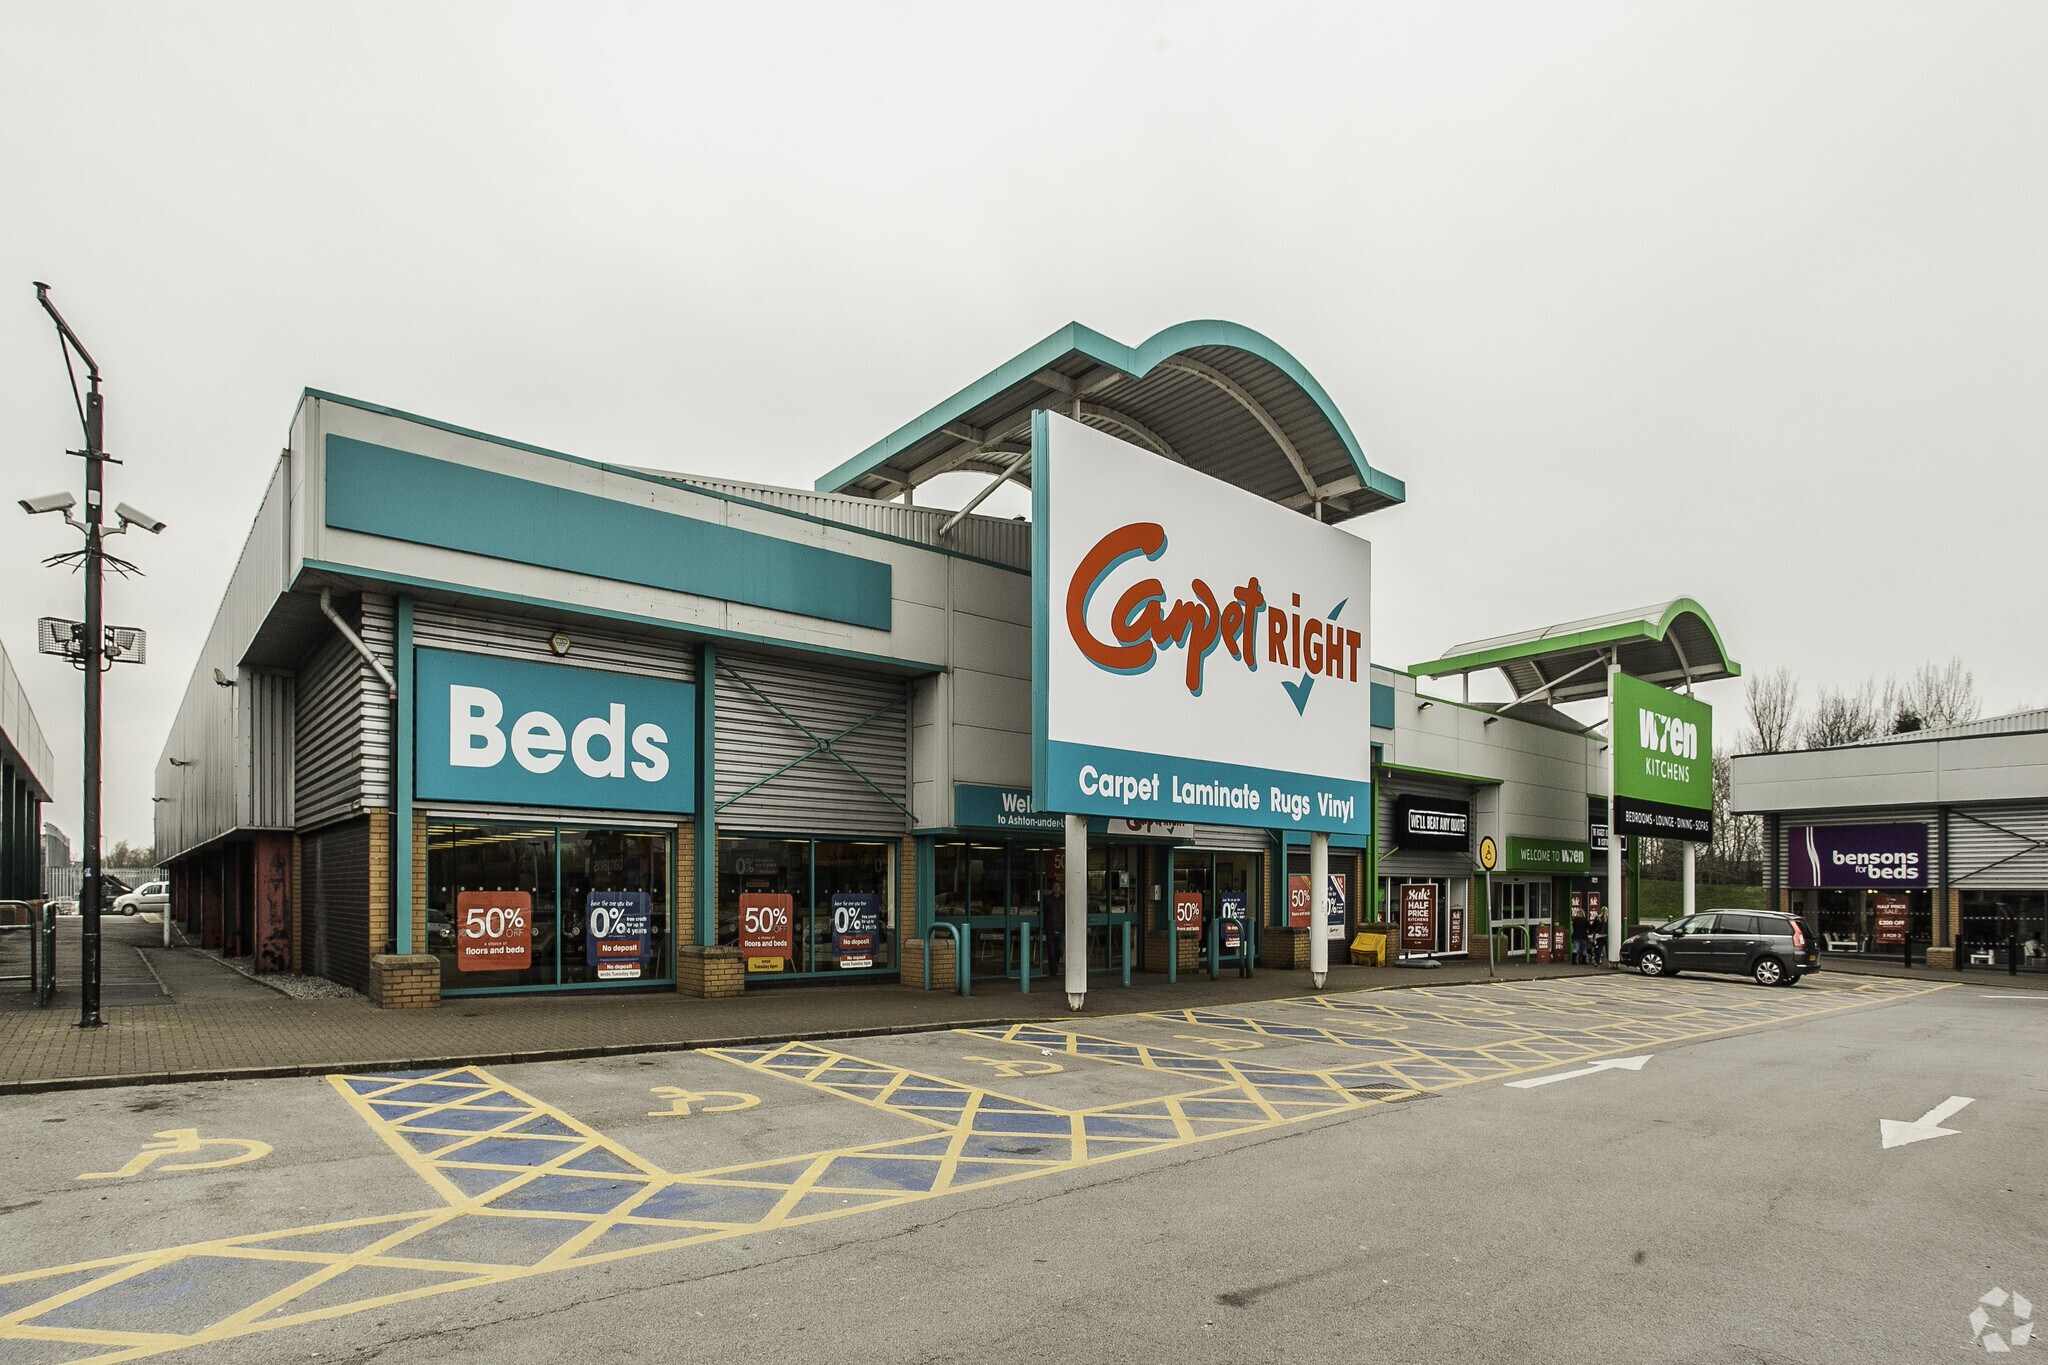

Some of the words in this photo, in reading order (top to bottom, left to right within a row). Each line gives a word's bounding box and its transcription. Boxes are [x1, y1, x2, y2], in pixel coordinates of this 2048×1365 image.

[450, 684, 669, 782] Beds
[1645, 757, 1690, 783] KITCHENS
[1079, 764, 1160, 806] Carpet
[1172, 775, 1261, 811] Laminate
[1270, 787, 1311, 822] Rugs
[1317, 792, 1355, 824] Vinyl
[997, 814, 1006, 825] to
[1008, 815, 1066, 828] Ashton-under-L
[1427, 815, 1440, 830] BEAT
[1440, 817, 1450, 831] ANY
[1451, 818, 1466, 832] QUOTE
[1625, 810, 1653, 825] BEDROOMS
[1655, 815, 1674, 828] LOUNGE
[1677, 817, 1693, 830] DINING
[1695, 819, 1709, 831] SOFAS
[1520, 848, 1551, 862] WELCOME
[1552, 850, 1560, 862] TO
[1832, 850, 1919, 865] bensons
[1855, 865, 1868, 873] for
[1868, 864, 1919, 879] beds
[1291, 889, 1310, 907] 50%
[1407, 887, 1430, 900] Sale
[1176, 902, 1200, 921] 50%
[1222, 902, 1238, 919] 0%
[1408, 901, 1429, 909] HALF
[466, 907, 524, 939] 50%
[590, 907, 626, 938] 0%
[744, 906, 788, 934] 50%
[834, 907, 861, 934] 0%
[631, 928, 648, 936] years
[1408, 925, 1429, 937] 25%
[466, 947, 488, 955] floors
[490, 946, 504, 954] and
[506, 946, 525, 954] beds
[613, 944, 638, 953] deposit
[851, 938, 870, 946] deposit
